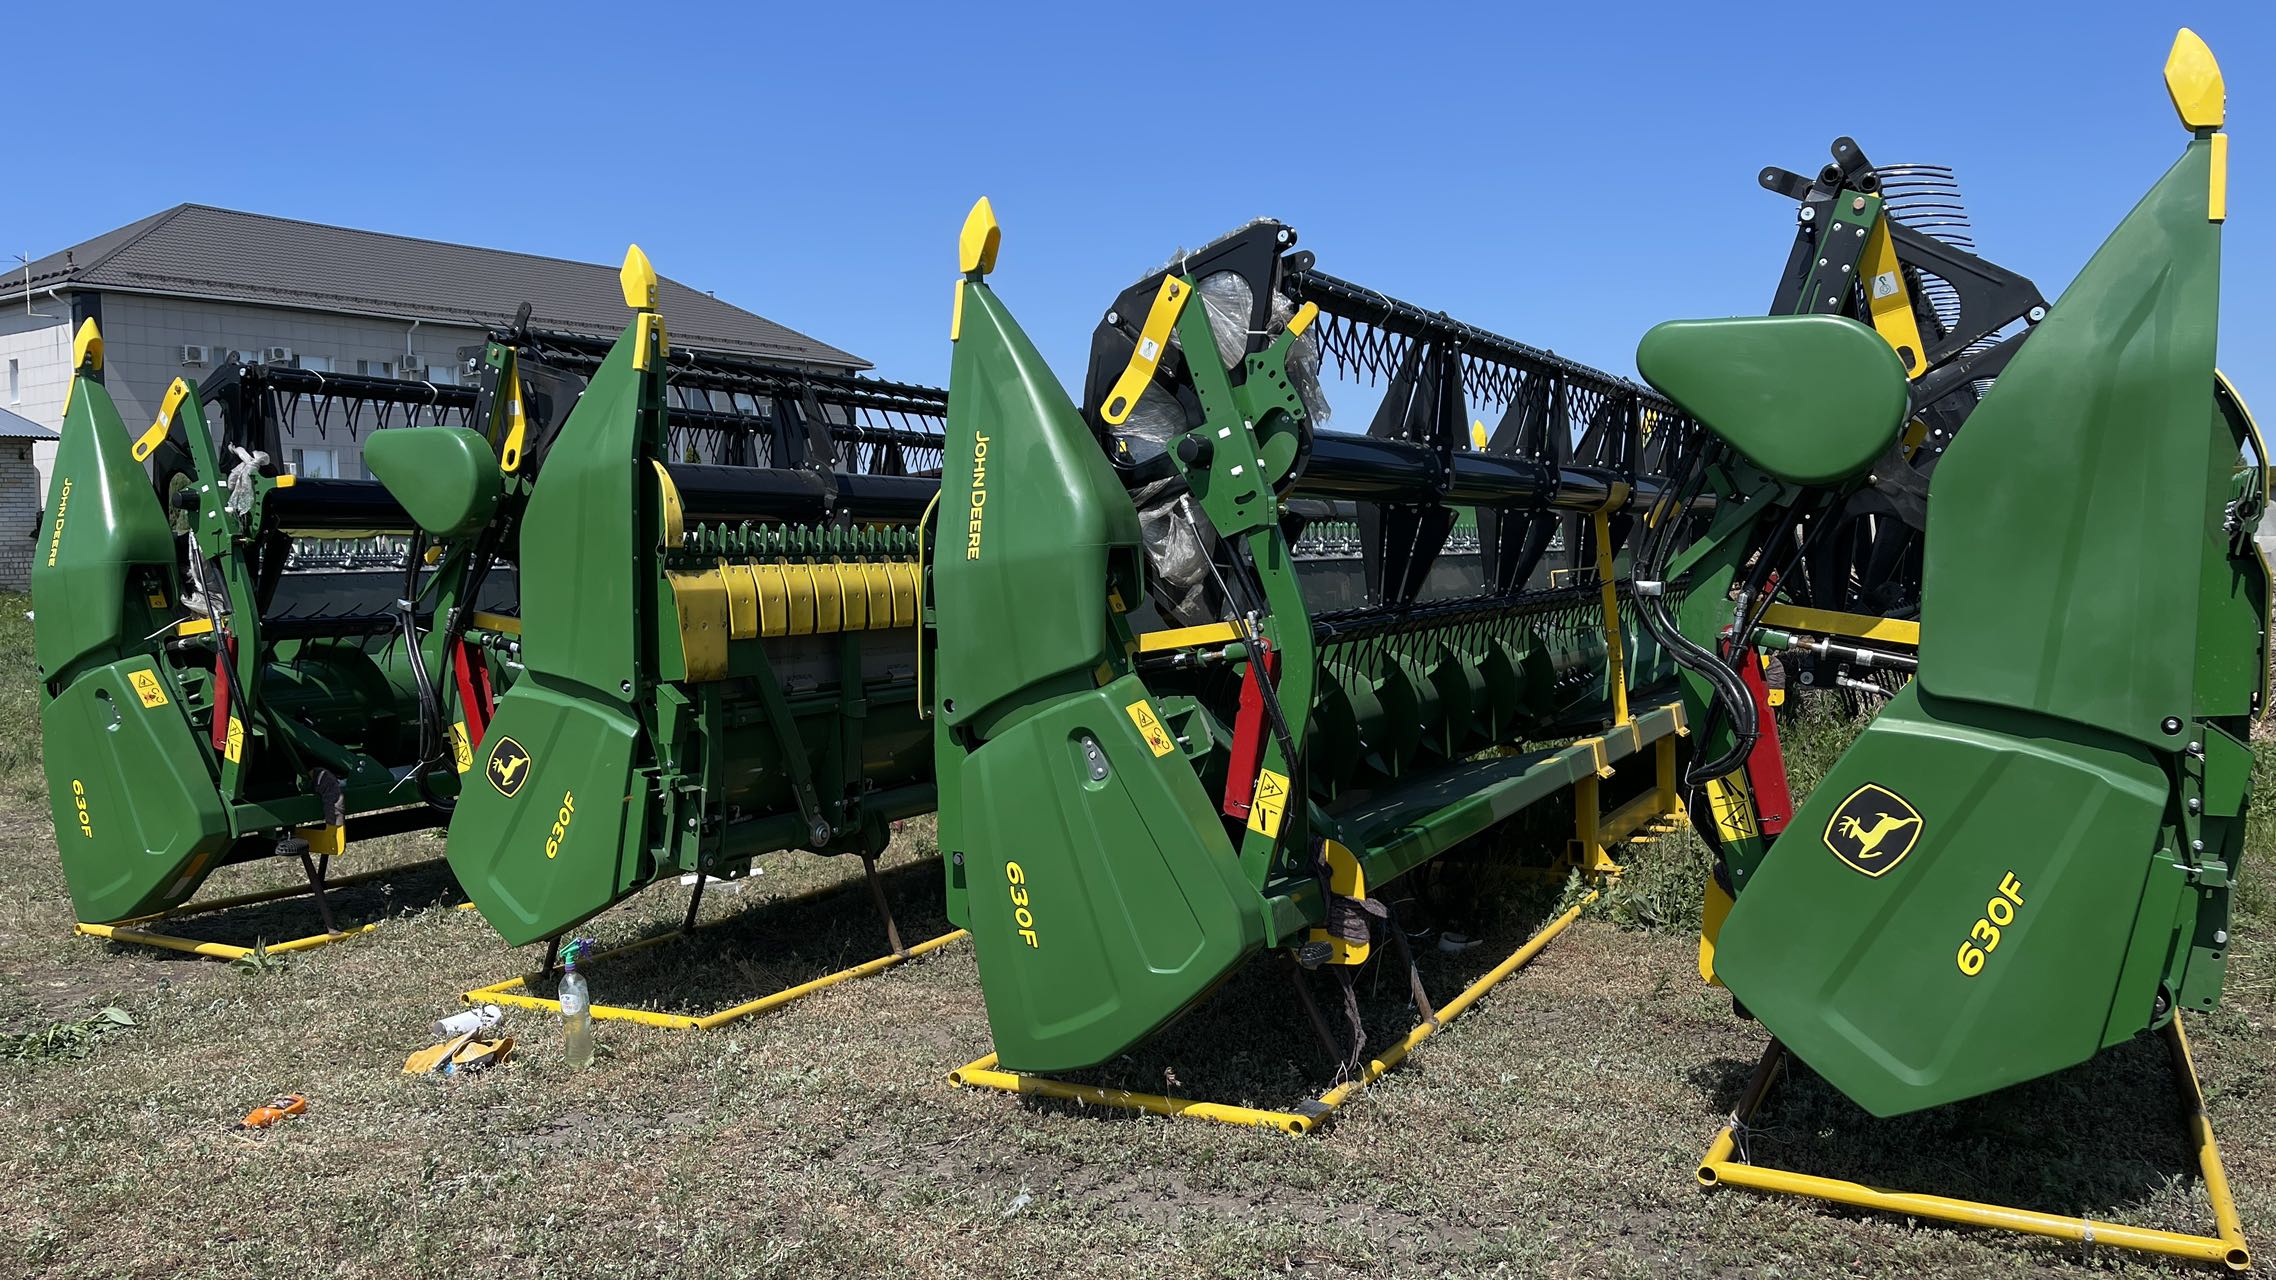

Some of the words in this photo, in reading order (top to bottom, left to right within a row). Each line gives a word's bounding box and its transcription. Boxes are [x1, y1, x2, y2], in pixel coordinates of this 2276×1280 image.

[972, 430, 990, 488] JOHN
[57, 477, 73, 518] JOHN
[967, 489, 987, 560] DEERE
[47, 518, 65, 567] DEERE
[72, 778, 93, 839] 630F
[545, 790, 575, 859] 630F
[1005, 861, 1039, 949] 630F
[1956, 869, 2026, 977] 630F
